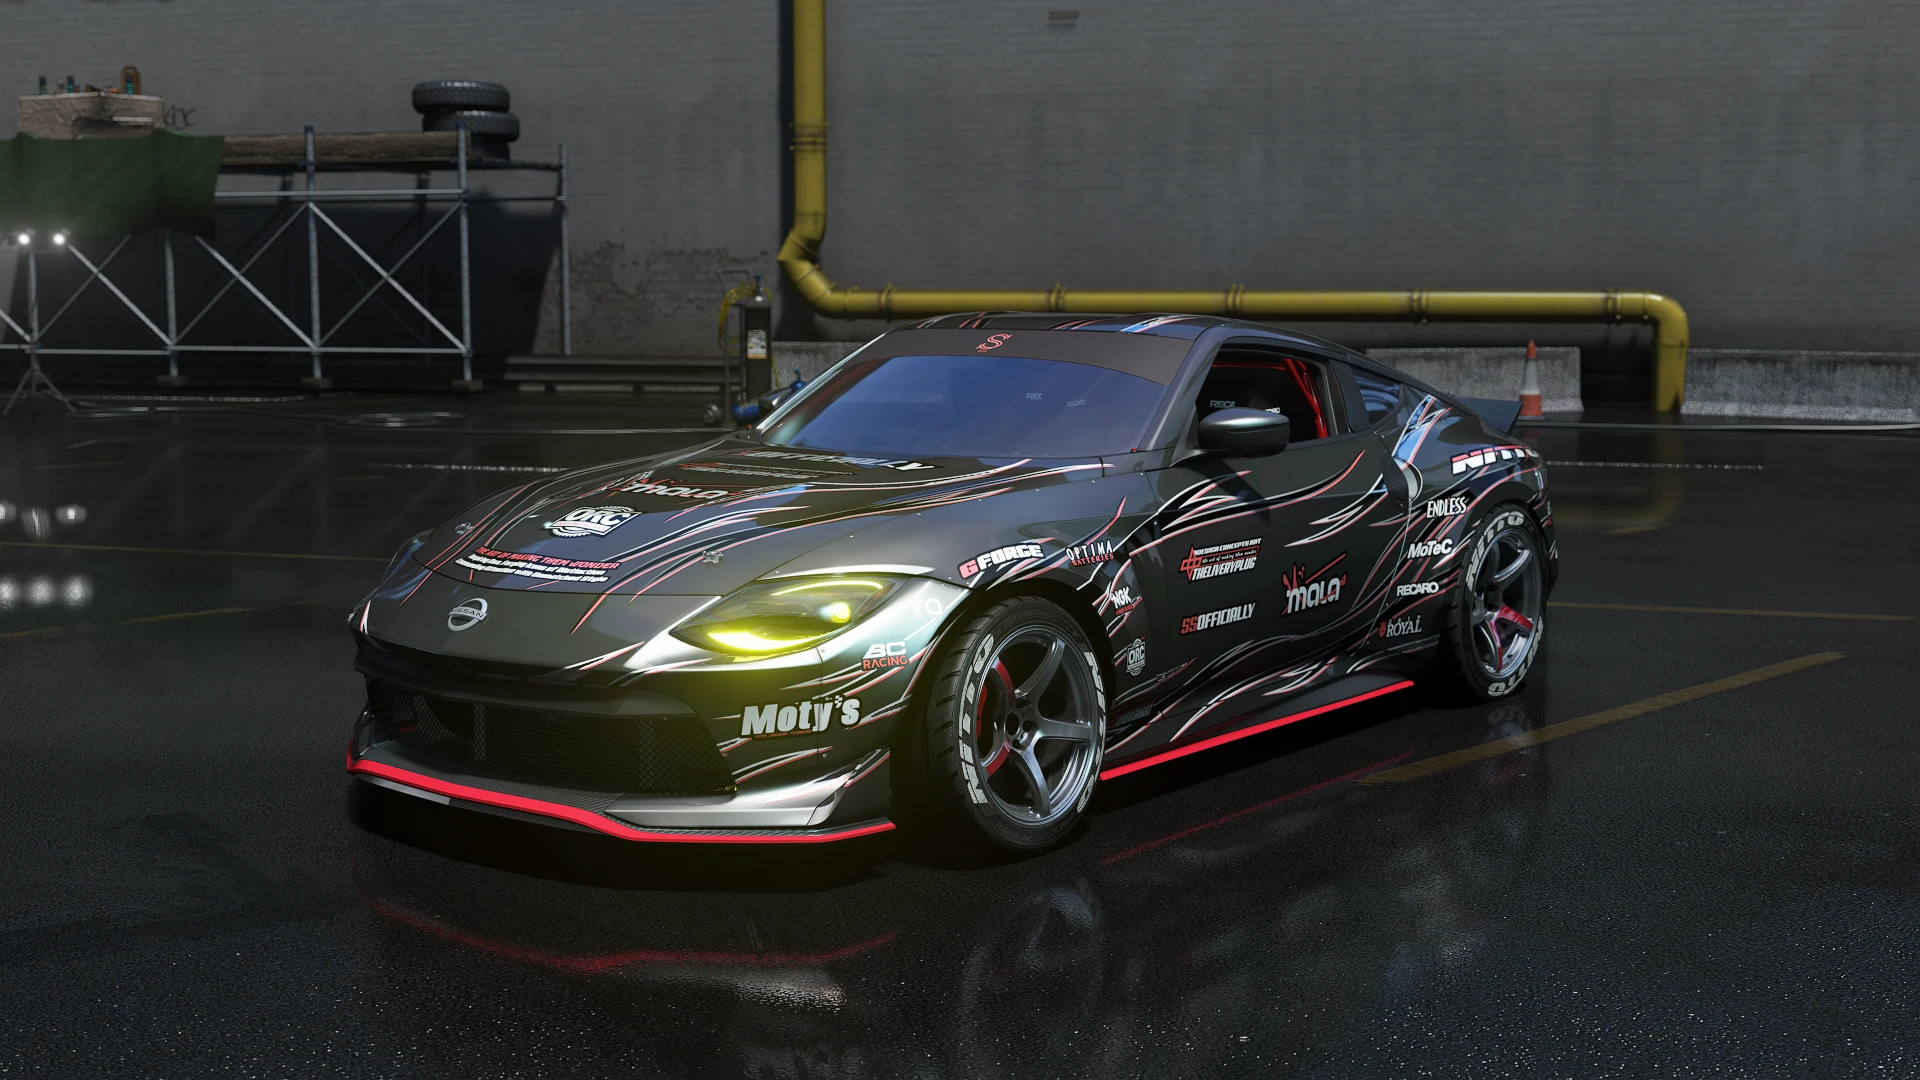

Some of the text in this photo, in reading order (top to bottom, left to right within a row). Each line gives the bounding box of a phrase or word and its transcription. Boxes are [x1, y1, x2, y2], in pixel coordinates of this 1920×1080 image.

[1451, 446, 1540, 475] NITTO
[565, 508, 631, 526] ORC
[1426, 497, 1467, 518] ENDLESS
[1066, 540, 1114, 561] OPTIMA
[1220, 541, 1249, 551] CONCEPTS
[1407, 538, 1453, 559] MoTeC
[1465, 511, 1525, 592] NITTO
[541, 557, 570, 567] THEM
[1071, 553, 1115, 567] BATTERIES
[1192, 557, 1258, 581] THELIVERYPLUG
[1112, 586, 1132, 609] NGK
[1396, 581, 1439, 597] RECARO
[451, 607, 485, 619] NISSAN
[1181, 602, 1256, 635] SSOFFICIALLY
[1385, 619, 1423, 638] ROYAL
[862, 641, 907, 659] BC
[1128, 645, 1145, 665] ORC
[862, 655, 908, 670] RACING
[741, 695, 860, 736] Moty's
[958, 633, 994, 804] NITTO
